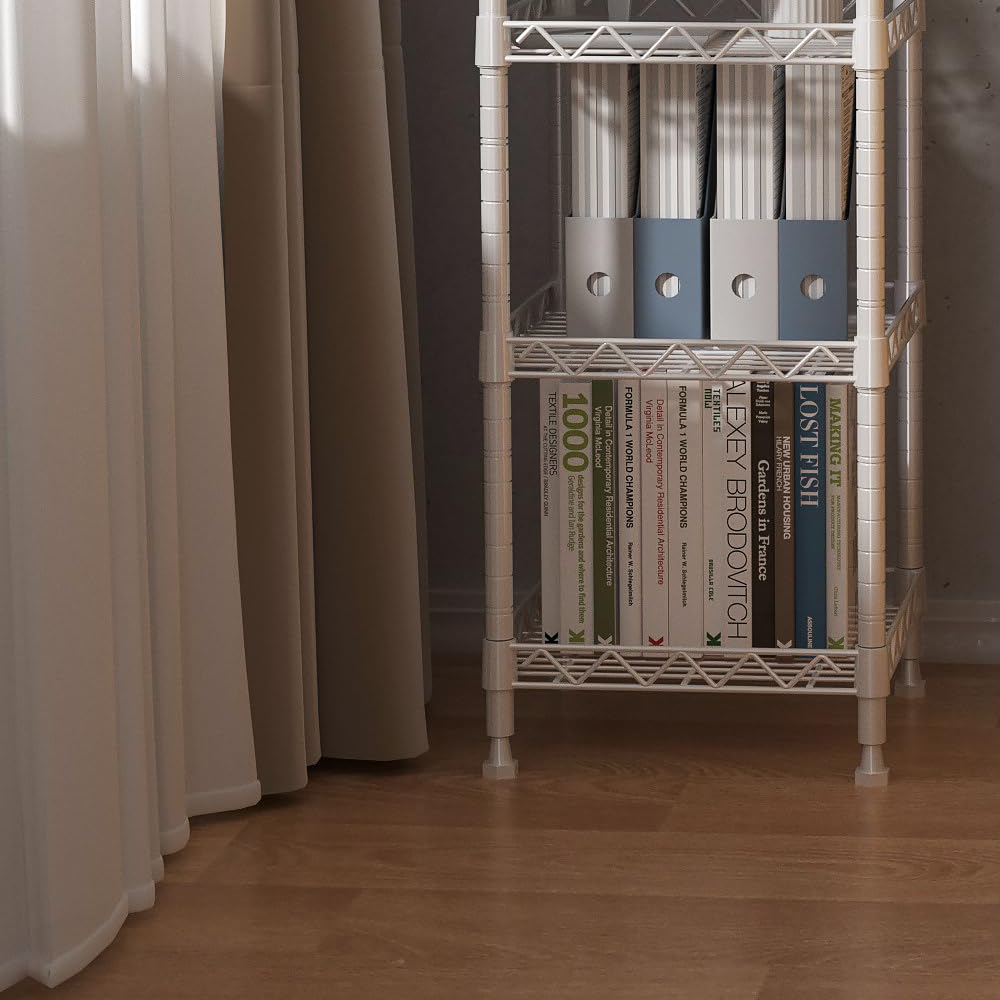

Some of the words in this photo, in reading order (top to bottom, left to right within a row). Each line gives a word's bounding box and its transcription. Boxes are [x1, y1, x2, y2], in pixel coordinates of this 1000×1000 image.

[548, 391, 557, 425] TEXTILE
[593, 406, 602, 435] Virginia
[604, 405, 613, 428] Detail
[624, 386, 633, 430] FORMULA
[644, 399, 653, 428] Virginia
[656, 399, 664, 421] Detail
[678, 385, 687, 429] FORMULA
[799, 384, 819, 448] LOST
[562, 393, 589, 472] 1000
[604, 429, 613, 437] in
[726, 380, 747, 470] ALEXEY
[829, 397, 842, 465] MAKING
[548, 428, 558, 476] DESIGNERS
[595, 437, 603, 468] McLeod
[624, 439, 633, 473] WORLD
[645, 431, 653, 463] McLeod
[655, 433, 665, 489] Contemporary
[679, 439, 688, 472] WORLD
[775, 436, 783, 460] HILARY
[782, 436, 791, 458] NEW
[603, 438, 614, 493] Contemporary
[775, 462, 783, 491] FRENCH
[782, 460, 791, 494] URBAN
[799, 453, 819, 508] FISH
[829, 470, 842, 487] IT
[576, 474, 585, 499] designs
[625, 475, 634, 528] CHAMPIONS
[679, 474, 688, 528] CHAMPIONS
[757, 459, 770, 514] Gardens
[605, 495, 614, 538] Residential
[657, 492, 665, 536] Residential
[758, 518, 770, 532] in
[782, 496, 791, 539] HOUSING
[576, 523, 586, 549] gardens
[578, 549, 586, 562] and
[605, 539, 614, 586] Architecture
[657, 537, 665, 585] Architecture
[726, 479, 748, 638] BRODOVITCH
[758, 534, 770, 581] France
[578, 563, 586, 584] where
[578, 584, 586, 592] to
[578, 592, 587, 606] find
[578, 606, 586, 624] them
